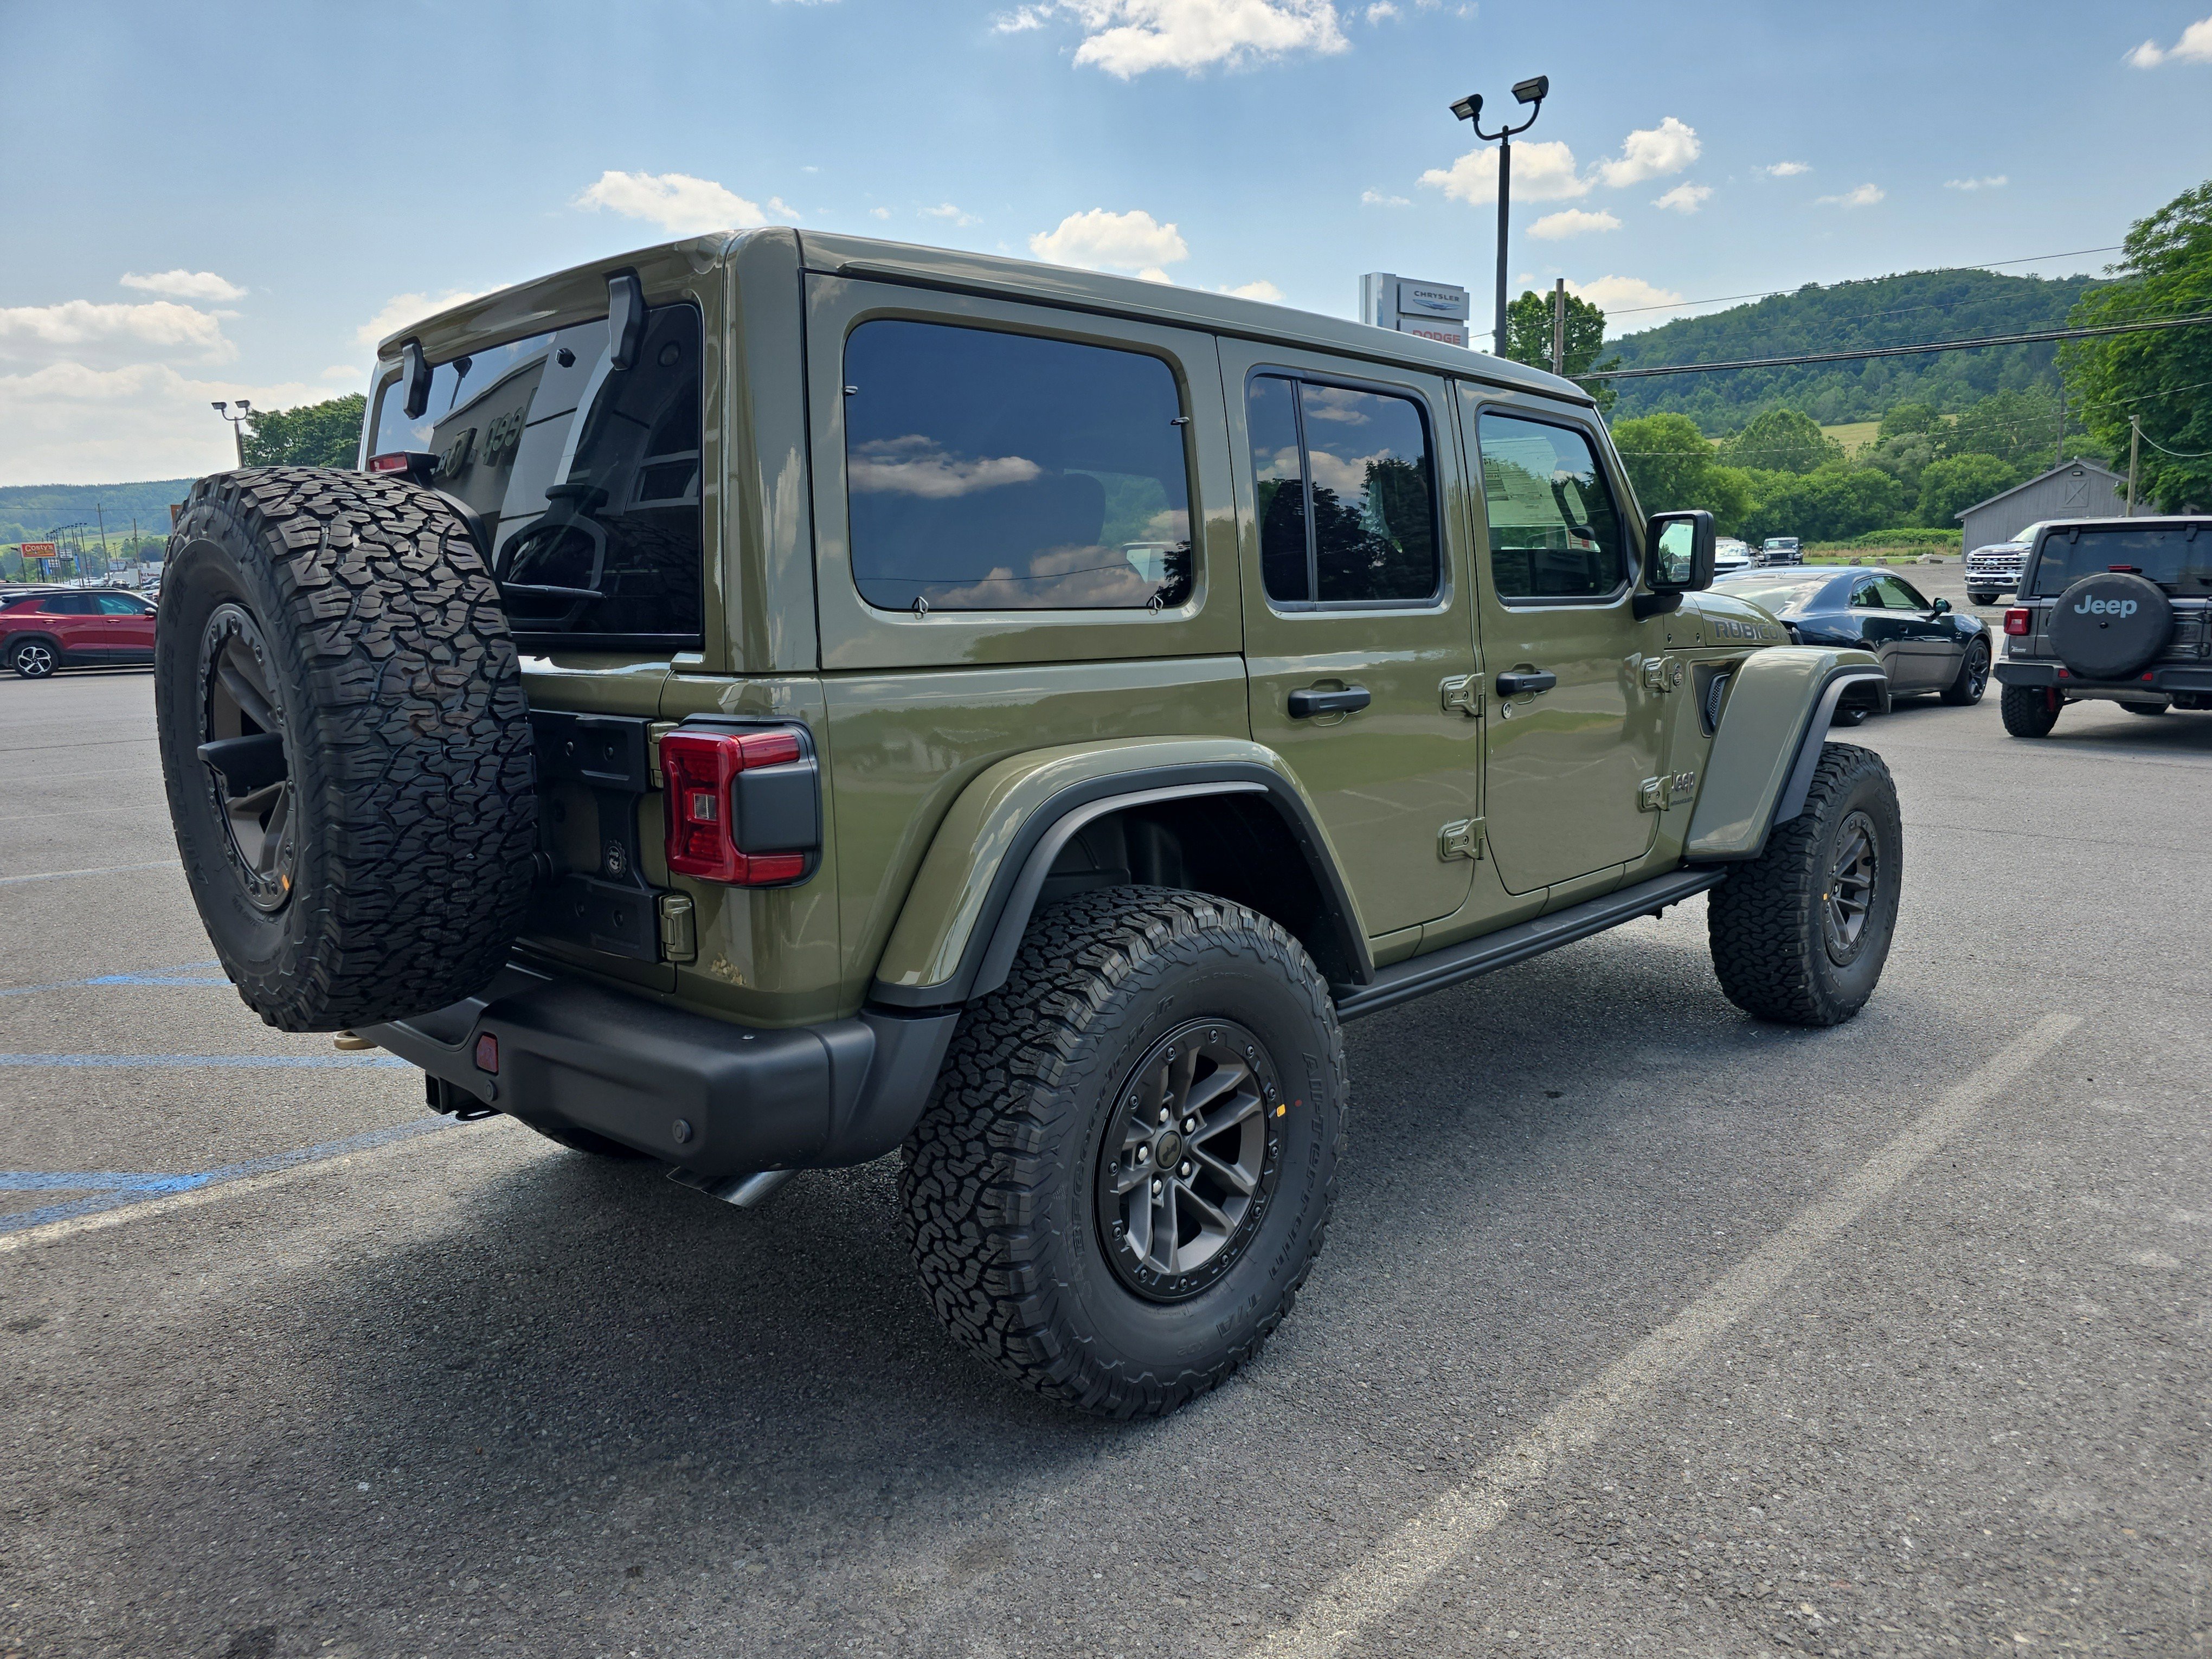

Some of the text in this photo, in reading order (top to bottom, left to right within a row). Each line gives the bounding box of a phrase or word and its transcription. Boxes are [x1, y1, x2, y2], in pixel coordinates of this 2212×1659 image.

[1414, 291, 1459, 302] CHRYSLER
[1413, 330, 1461, 344] DODGE
[2074, 595, 2137, 618] Jeep
[1671, 770, 1694, 793] Jeep
